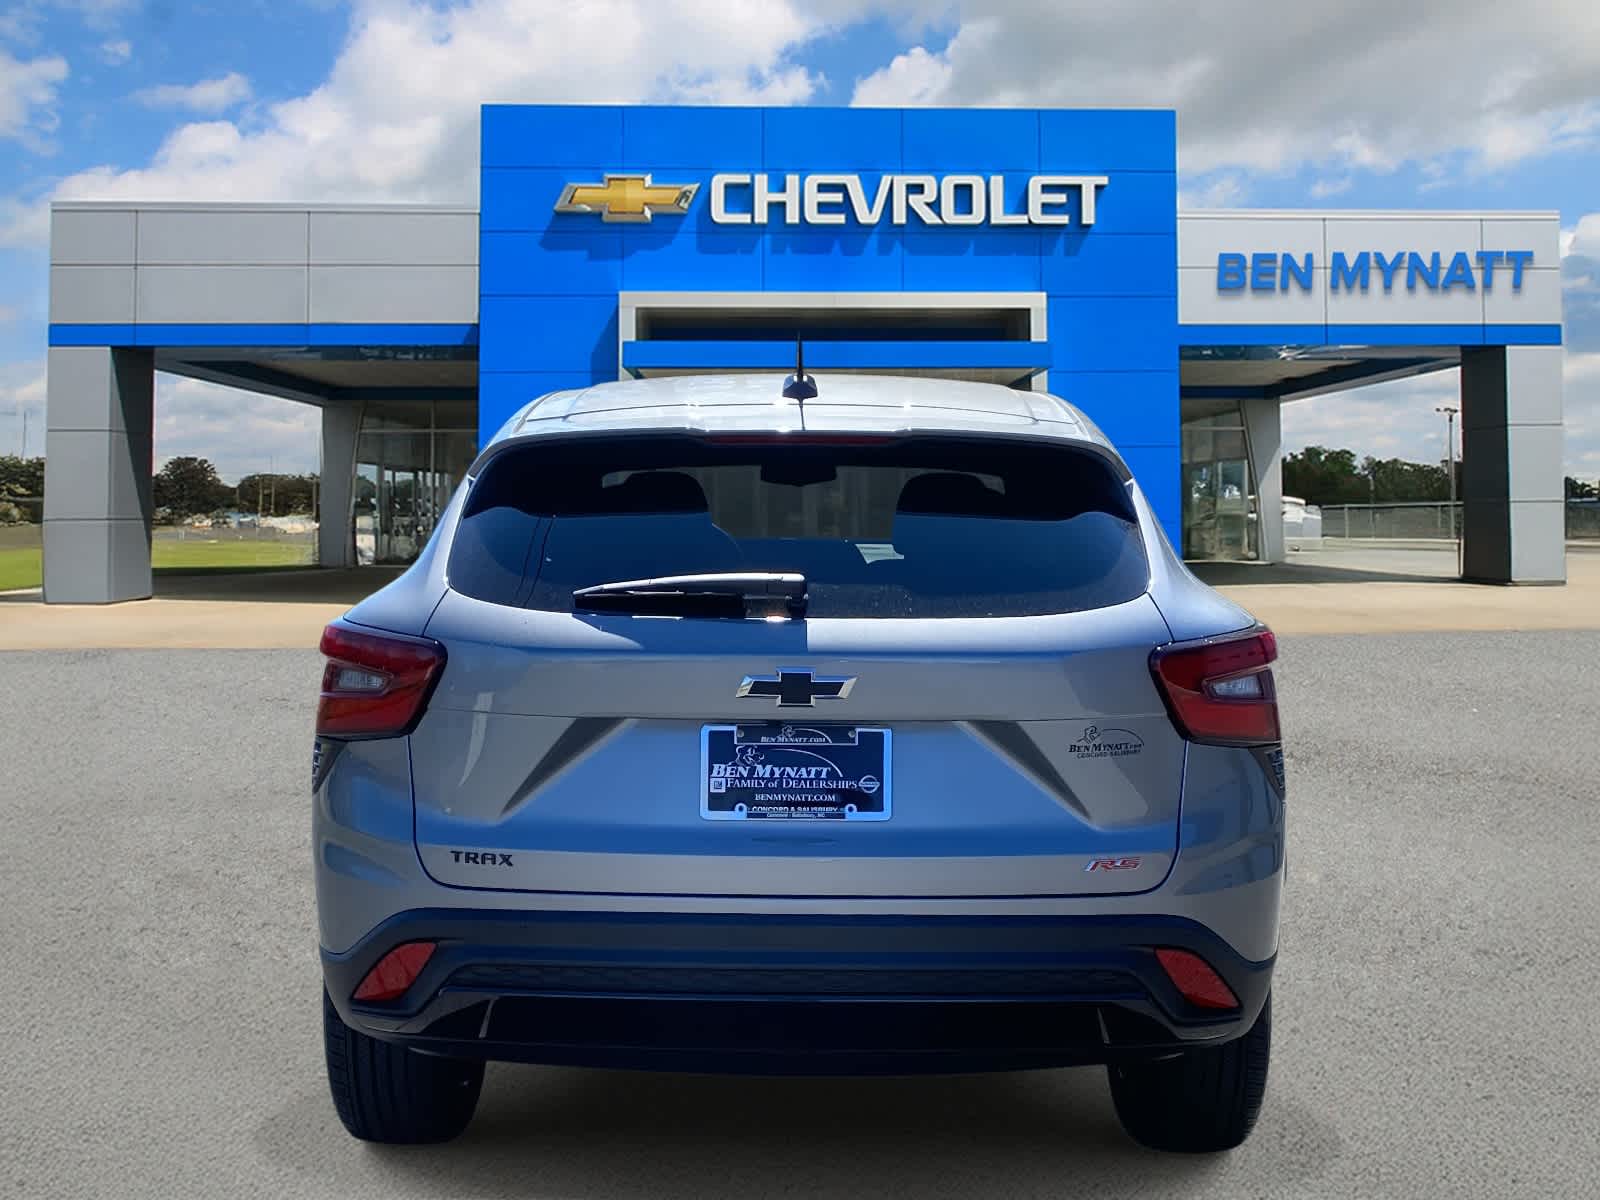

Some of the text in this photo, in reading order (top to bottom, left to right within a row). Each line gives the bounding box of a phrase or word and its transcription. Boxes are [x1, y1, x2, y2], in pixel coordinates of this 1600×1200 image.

[710, 173, 1109, 225] CHEVROLET
[1216, 250, 1534, 291] BEN MYNATT
[1068, 744, 1090, 752] BEN
[710, 764, 831, 778] BEN MYNATT
[727, 777, 767, 789] FAMILY
[768, 778, 779, 789] of
[783, 778, 858, 790] DEALERSHIPS
[755, 793, 836, 802] BENMYNATT.COM
[450, 850, 514, 867] TRAX
[1084, 858, 1140, 872] RS
